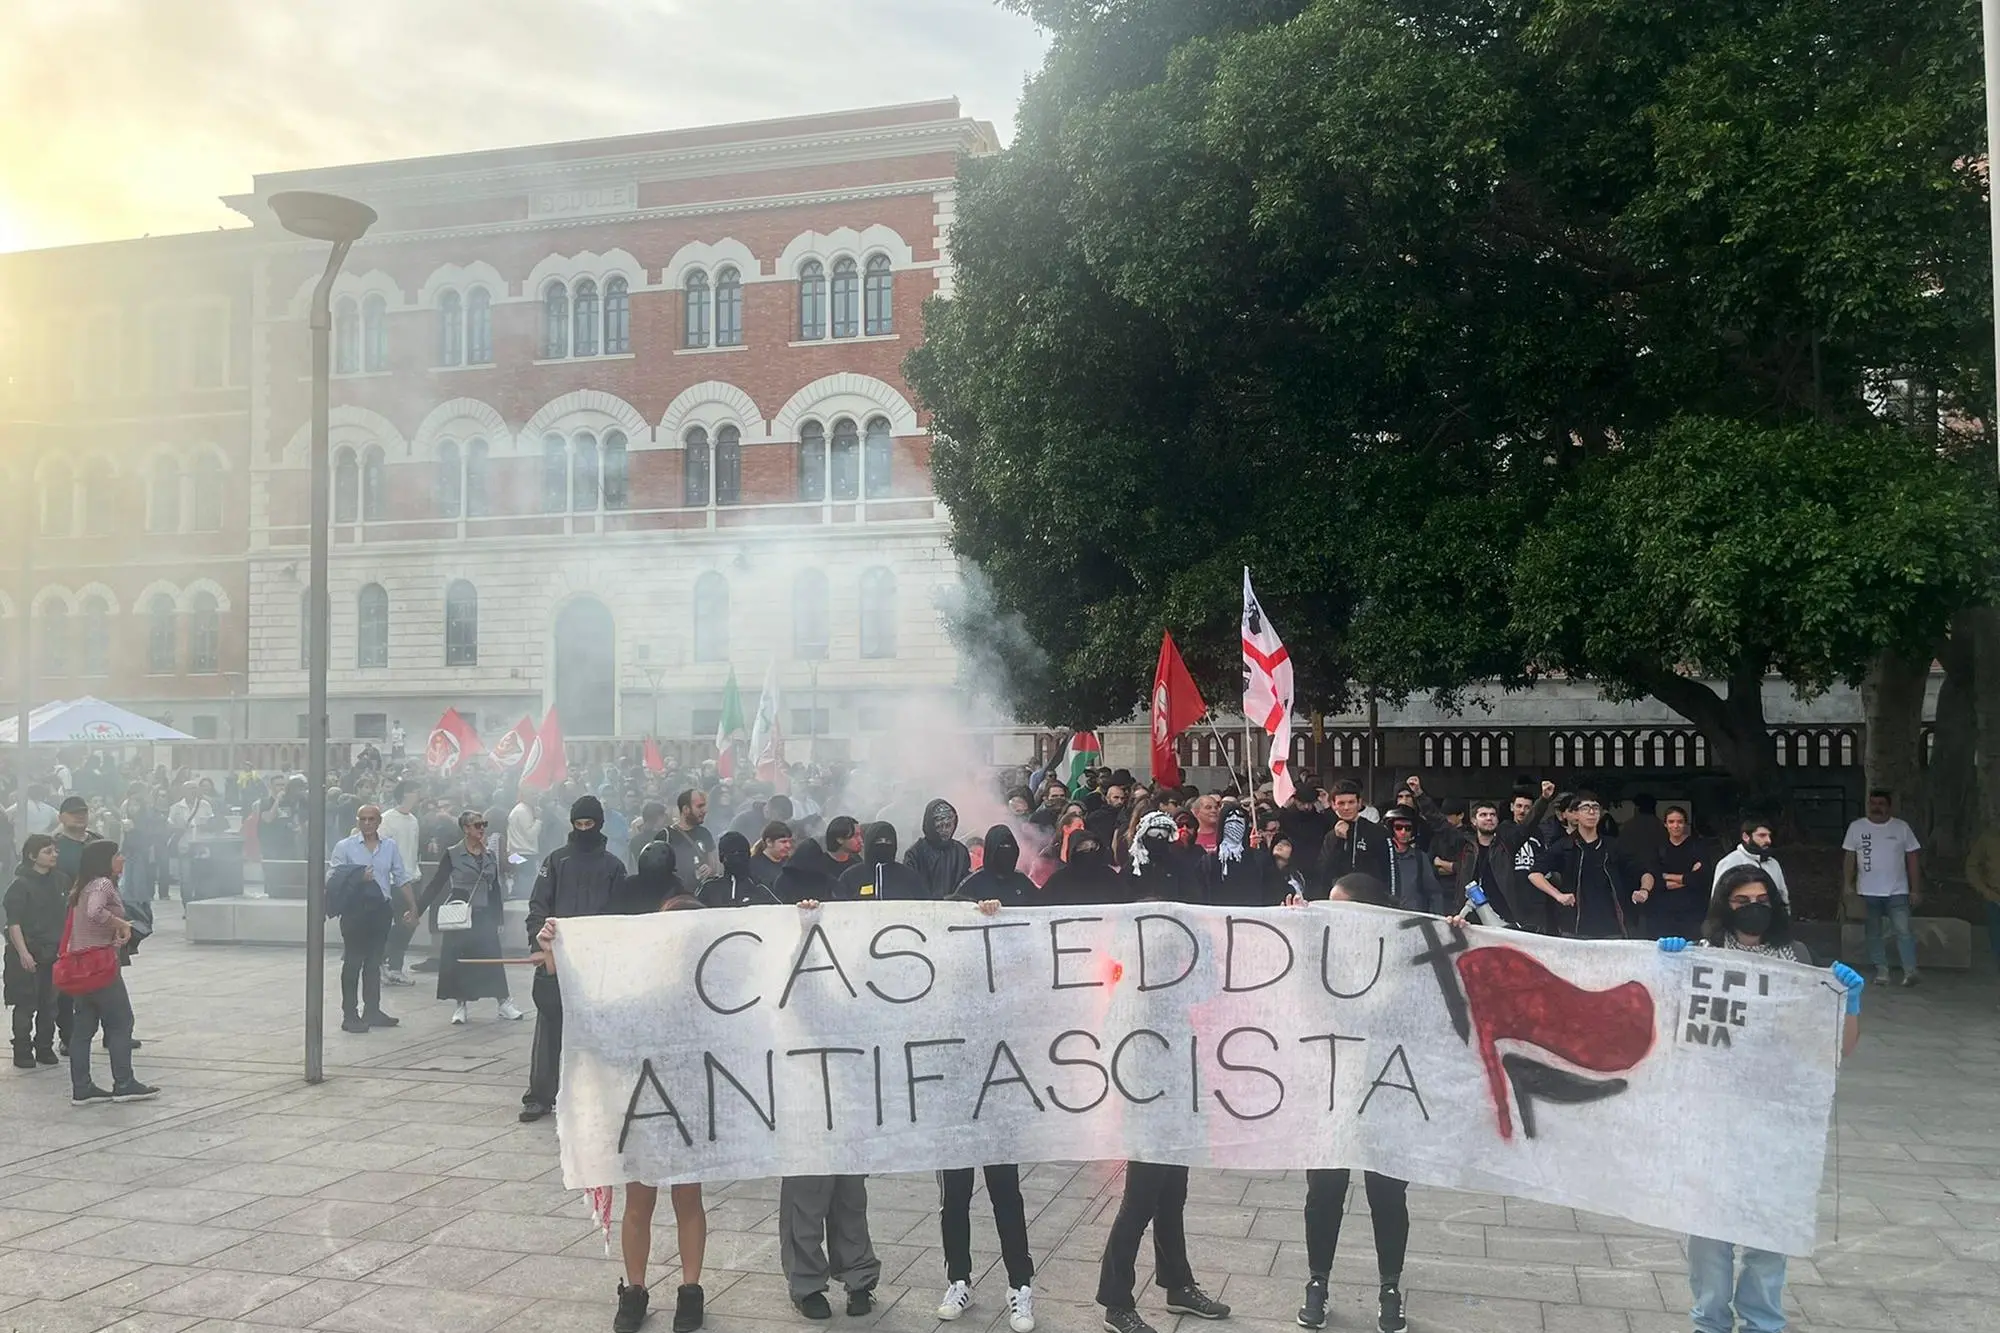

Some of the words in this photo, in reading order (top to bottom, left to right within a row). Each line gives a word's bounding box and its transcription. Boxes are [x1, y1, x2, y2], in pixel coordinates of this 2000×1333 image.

[1861, 832, 1872, 873] CLIQUE
[694, 914, 1385, 1015] CASTEDDU
[1685, 1022, 1732, 1049] NA
[618, 1026, 1430, 1154] ANTIFASCISTA
